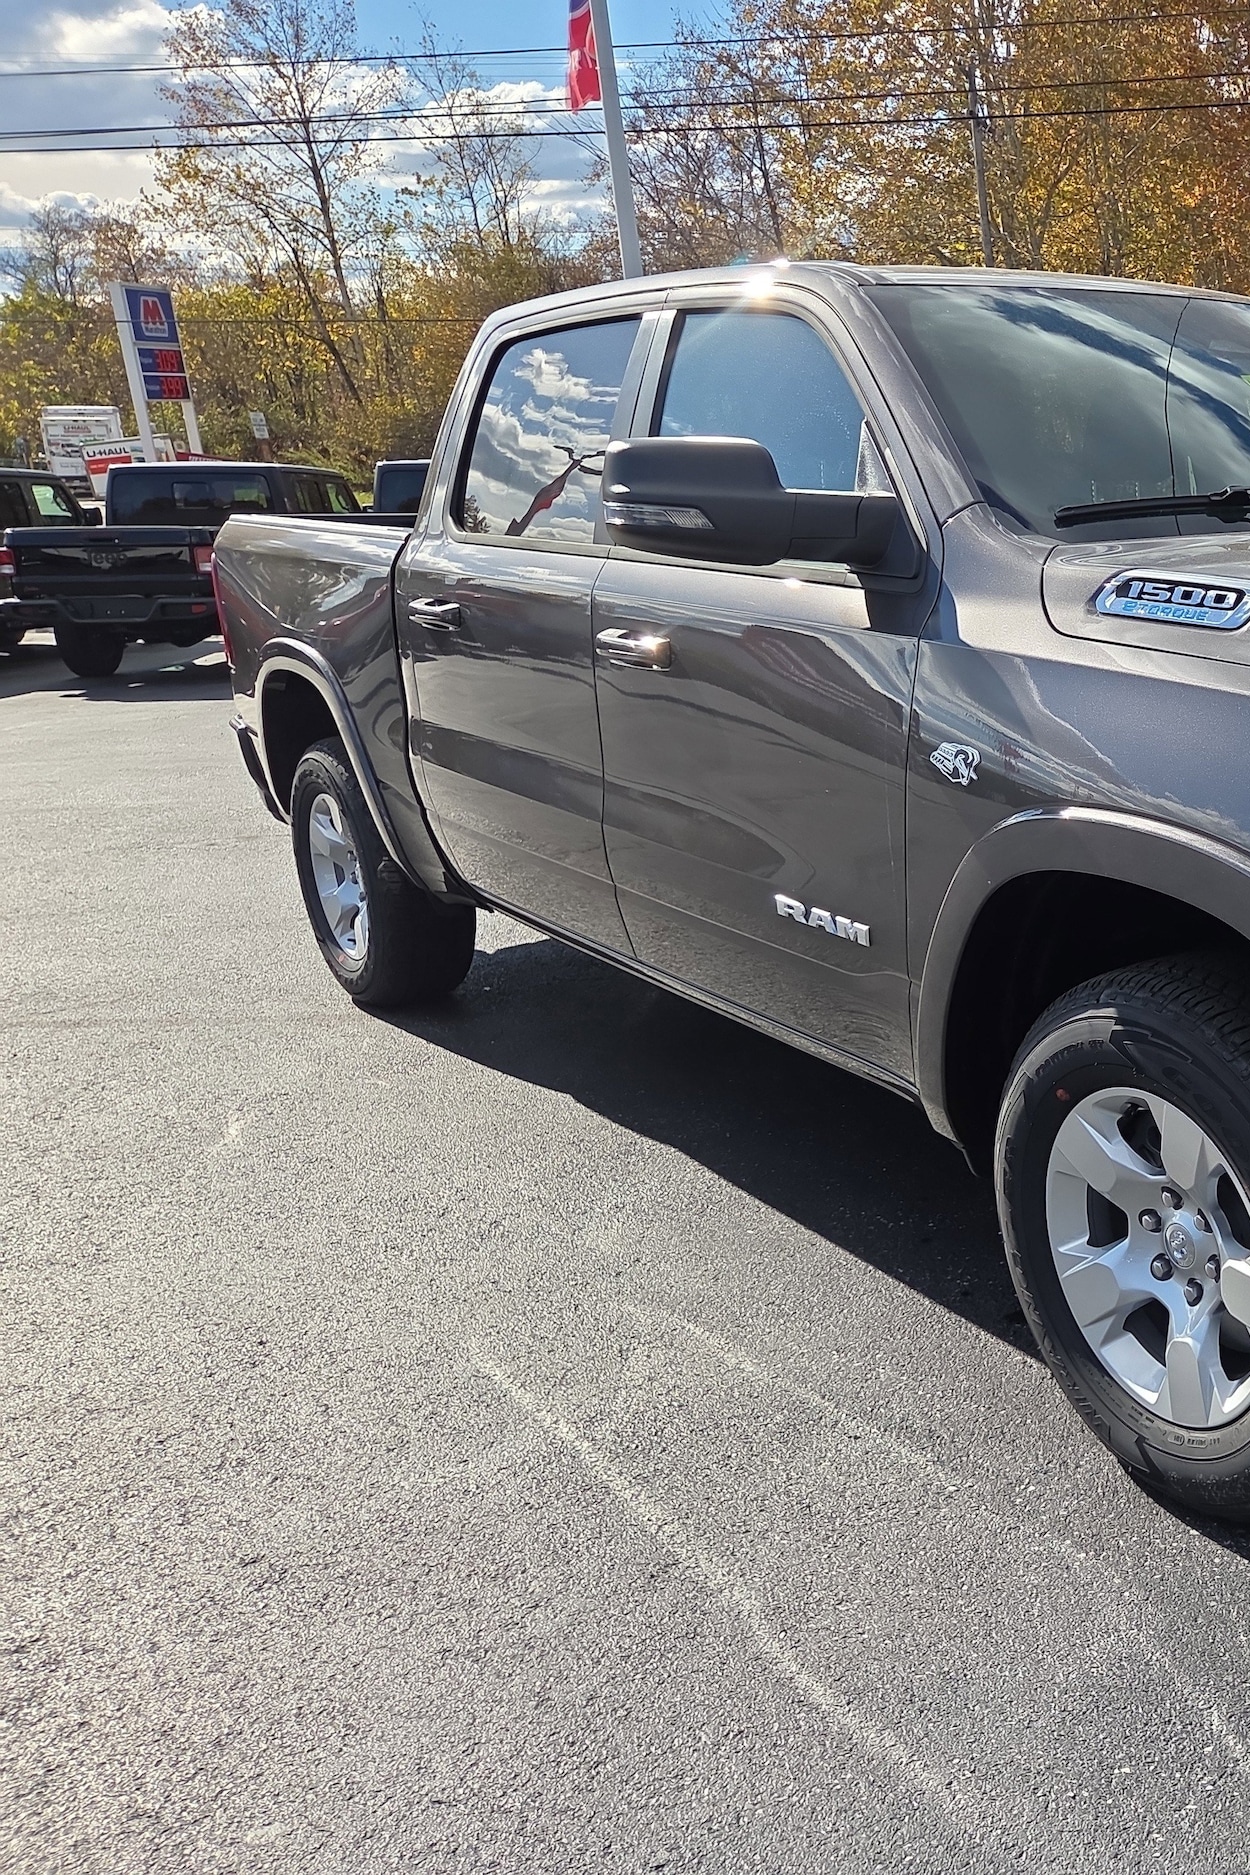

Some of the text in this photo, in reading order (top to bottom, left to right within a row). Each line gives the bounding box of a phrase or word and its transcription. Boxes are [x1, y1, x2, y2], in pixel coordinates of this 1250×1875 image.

[86, 447, 130, 458] U-HAUL
[1128, 581, 1238, 609] 1500
[774, 893, 870, 947] RAM
